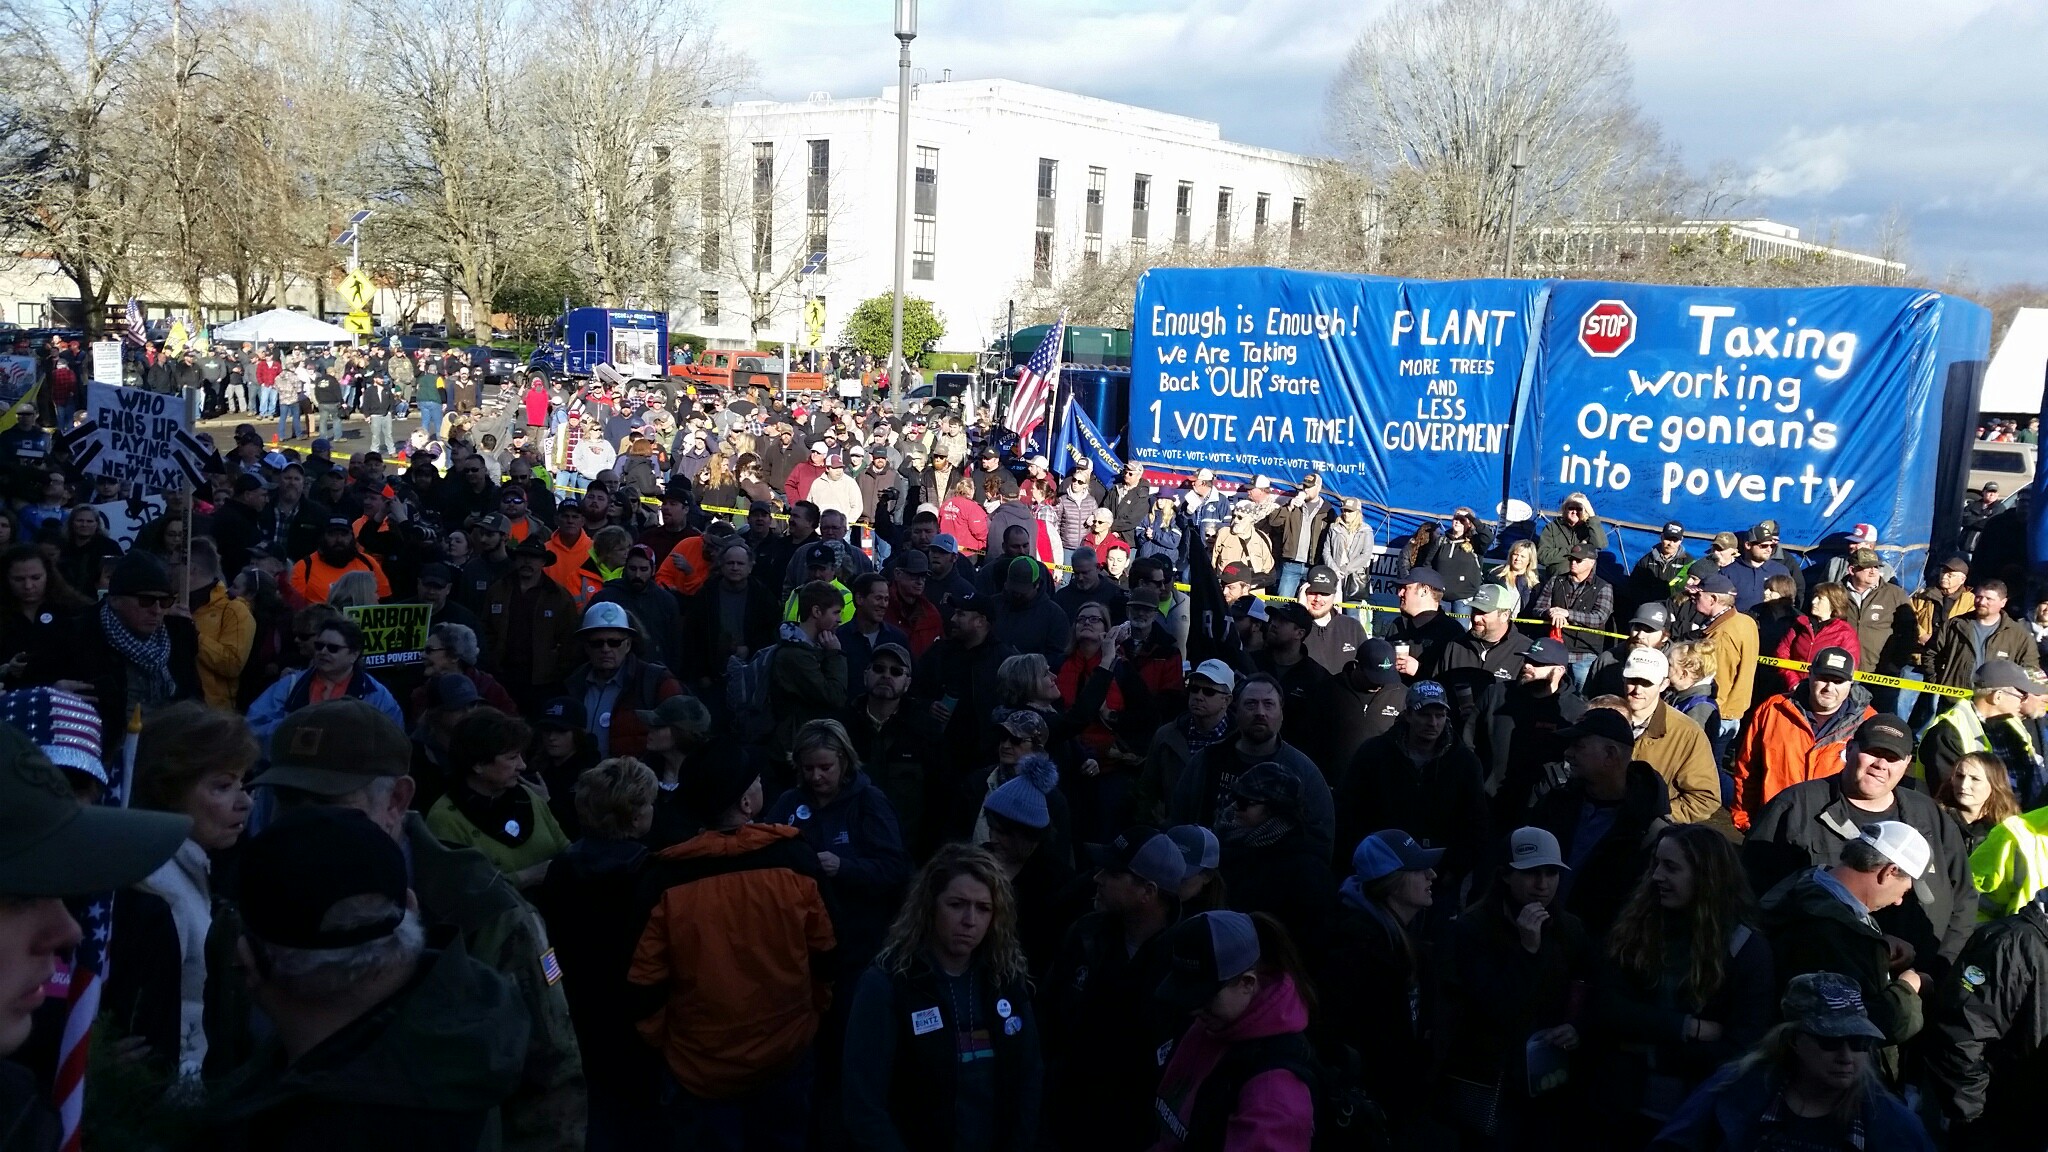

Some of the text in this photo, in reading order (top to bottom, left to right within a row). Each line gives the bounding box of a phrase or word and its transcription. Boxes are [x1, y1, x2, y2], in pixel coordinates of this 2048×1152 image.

[1152, 305, 1226, 338] Enough
[1237, 304, 1254, 334] is
[1391, 308, 1516, 347] PLANT
[1586, 312, 1629, 338] STOP
[1195, 342, 1230, 365] Are
[1239, 341, 1297, 366] Taking
[1689, 305, 1857, 379] Taxing
[1400, 358, 1495, 377] MORE TREES
[1159, 370, 1200, 392] Back
[1268, 374, 1320, 396] State
[1426, 379, 1458, 397] AND
[115, 388, 165, 416] WHO
[1417, 397, 1467, 421] LESS
[99, 407, 179, 442] ENDS UP
[1149, 399, 1162, 444] 1
[1174, 411, 1238, 443] VOTE
[1302, 415, 1354, 447] TIME!
[1577, 402, 1838, 453] Oregonian's
[112, 432, 171, 459] PAYING
[102, 458, 140, 481] NEW
[125, 454, 153, 469] THE
[1559, 444, 1631, 490] into
[361, 630, 385, 652] AX
[364, 655, 386, 666] ATES
[1416, 684, 1444, 694] TRUMP
[1757, 656, 1965, 696] CAUT CAUTION CAUTION
